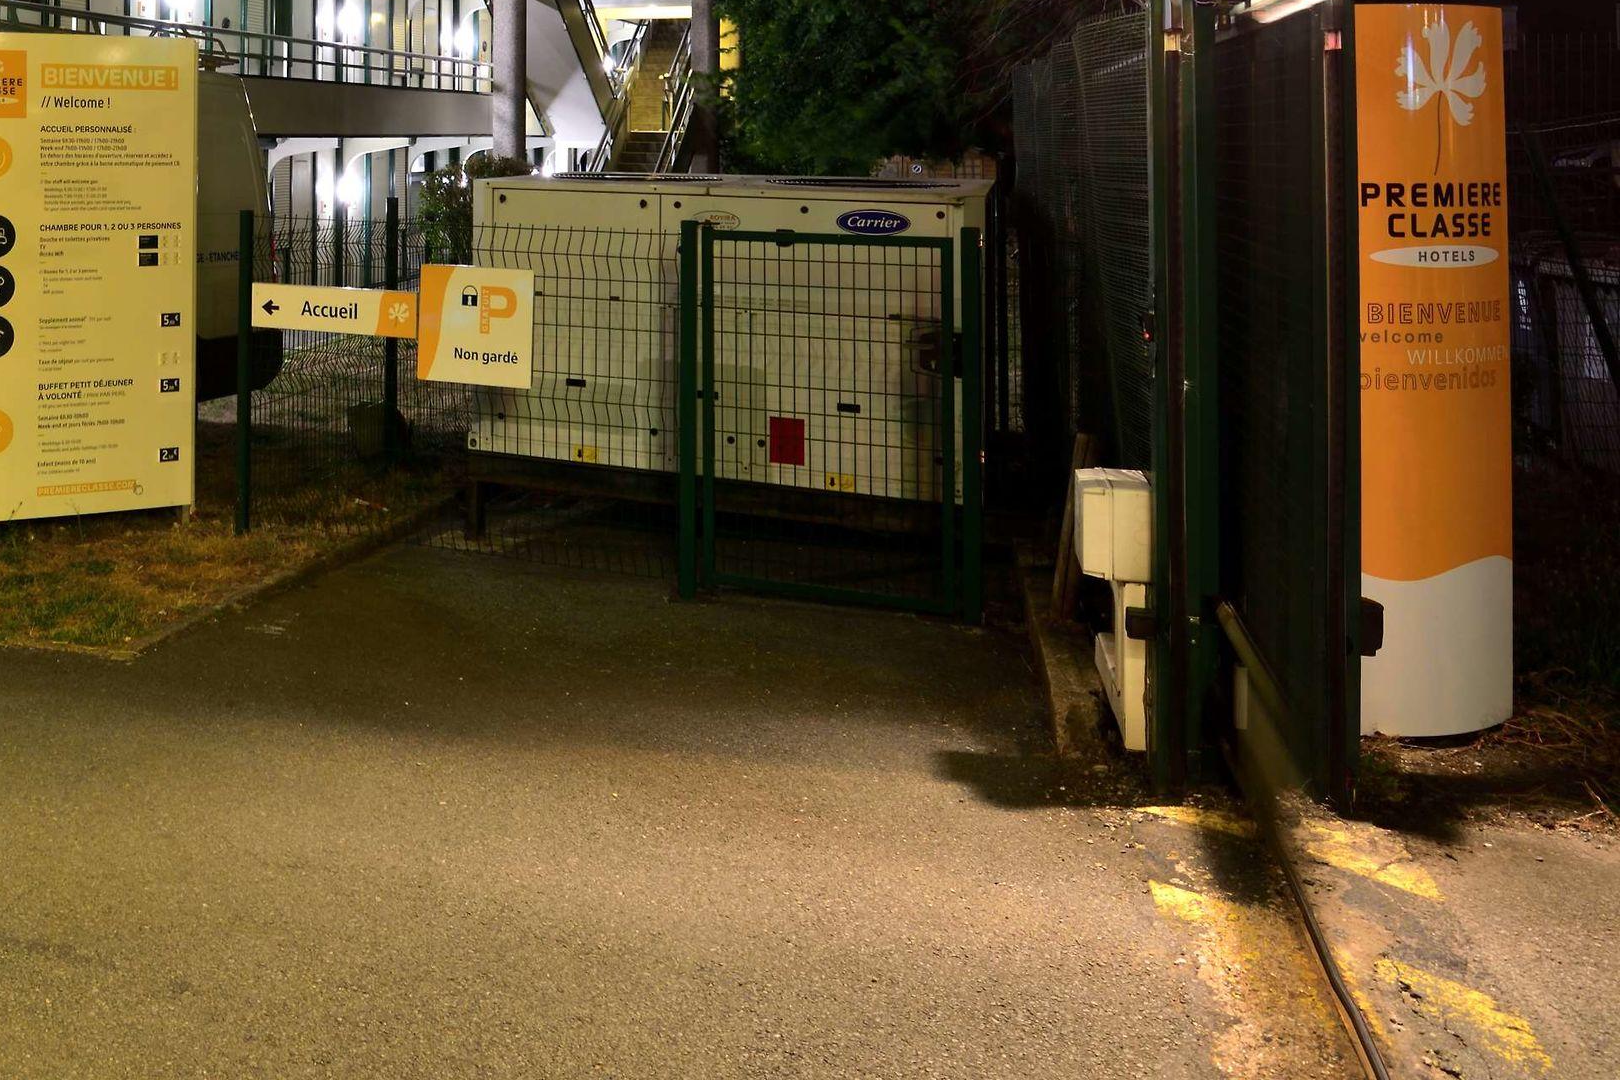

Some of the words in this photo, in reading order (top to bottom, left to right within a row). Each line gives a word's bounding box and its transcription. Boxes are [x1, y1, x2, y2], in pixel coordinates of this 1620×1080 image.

[44, 67, 166, 87] BIENVENUE
[53, 96, 104, 108] Welcome
[40, 125, 73, 133] ACCUEIL
[75, 124, 132, 133] PERSONNALISÉ
[1361, 182, 1501, 207] PREMIERE
[40, 224, 78, 232] CHAMBRE
[80, 223, 102, 232] POUR
[111, 223, 116, 231] 2
[117, 223, 129, 231] OU
[137, 222, 182, 230] PERSONNES
[847, 216, 901, 229] Carrier
[1388, 213, 1491, 238] CLASSE
[1418, 250, 1475, 262] HOTELS
[301, 300, 358, 320] Accueil
[1367, 300, 1501, 324] BIENVENUE
[454, 348, 479, 361] Non
[482, 350, 518, 365] gardé
[38, 382, 67, 390] BUFFET
[70, 381, 91, 389] PETIT
[93, 379, 133, 388] DÉJEUNER
[46, 391, 82, 400] VOLONTÉ
